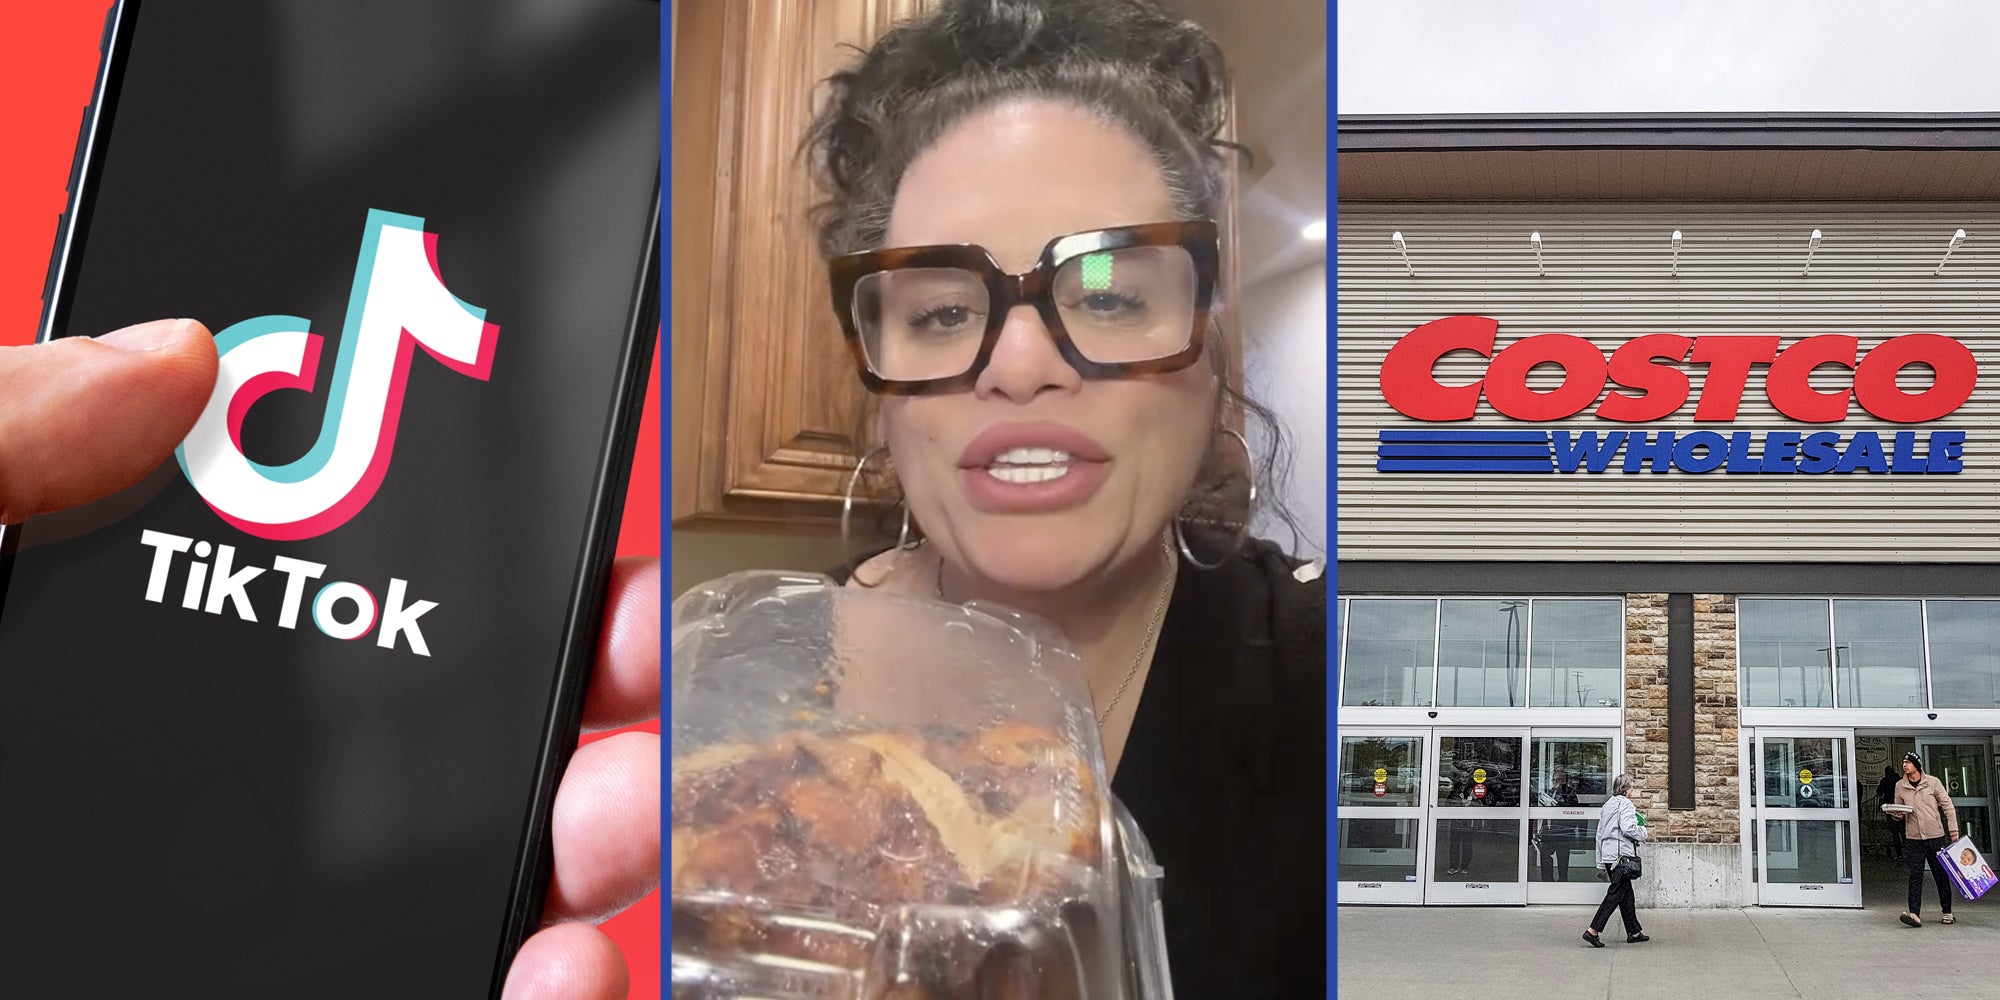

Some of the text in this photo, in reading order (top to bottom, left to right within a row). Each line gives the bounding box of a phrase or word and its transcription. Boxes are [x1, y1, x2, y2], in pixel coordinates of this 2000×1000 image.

[1379, 315, 1977, 422] COSTCO
[1551, 431, 1965, 474] WHOLESALE
[140, 529, 439, 656] TikTok
